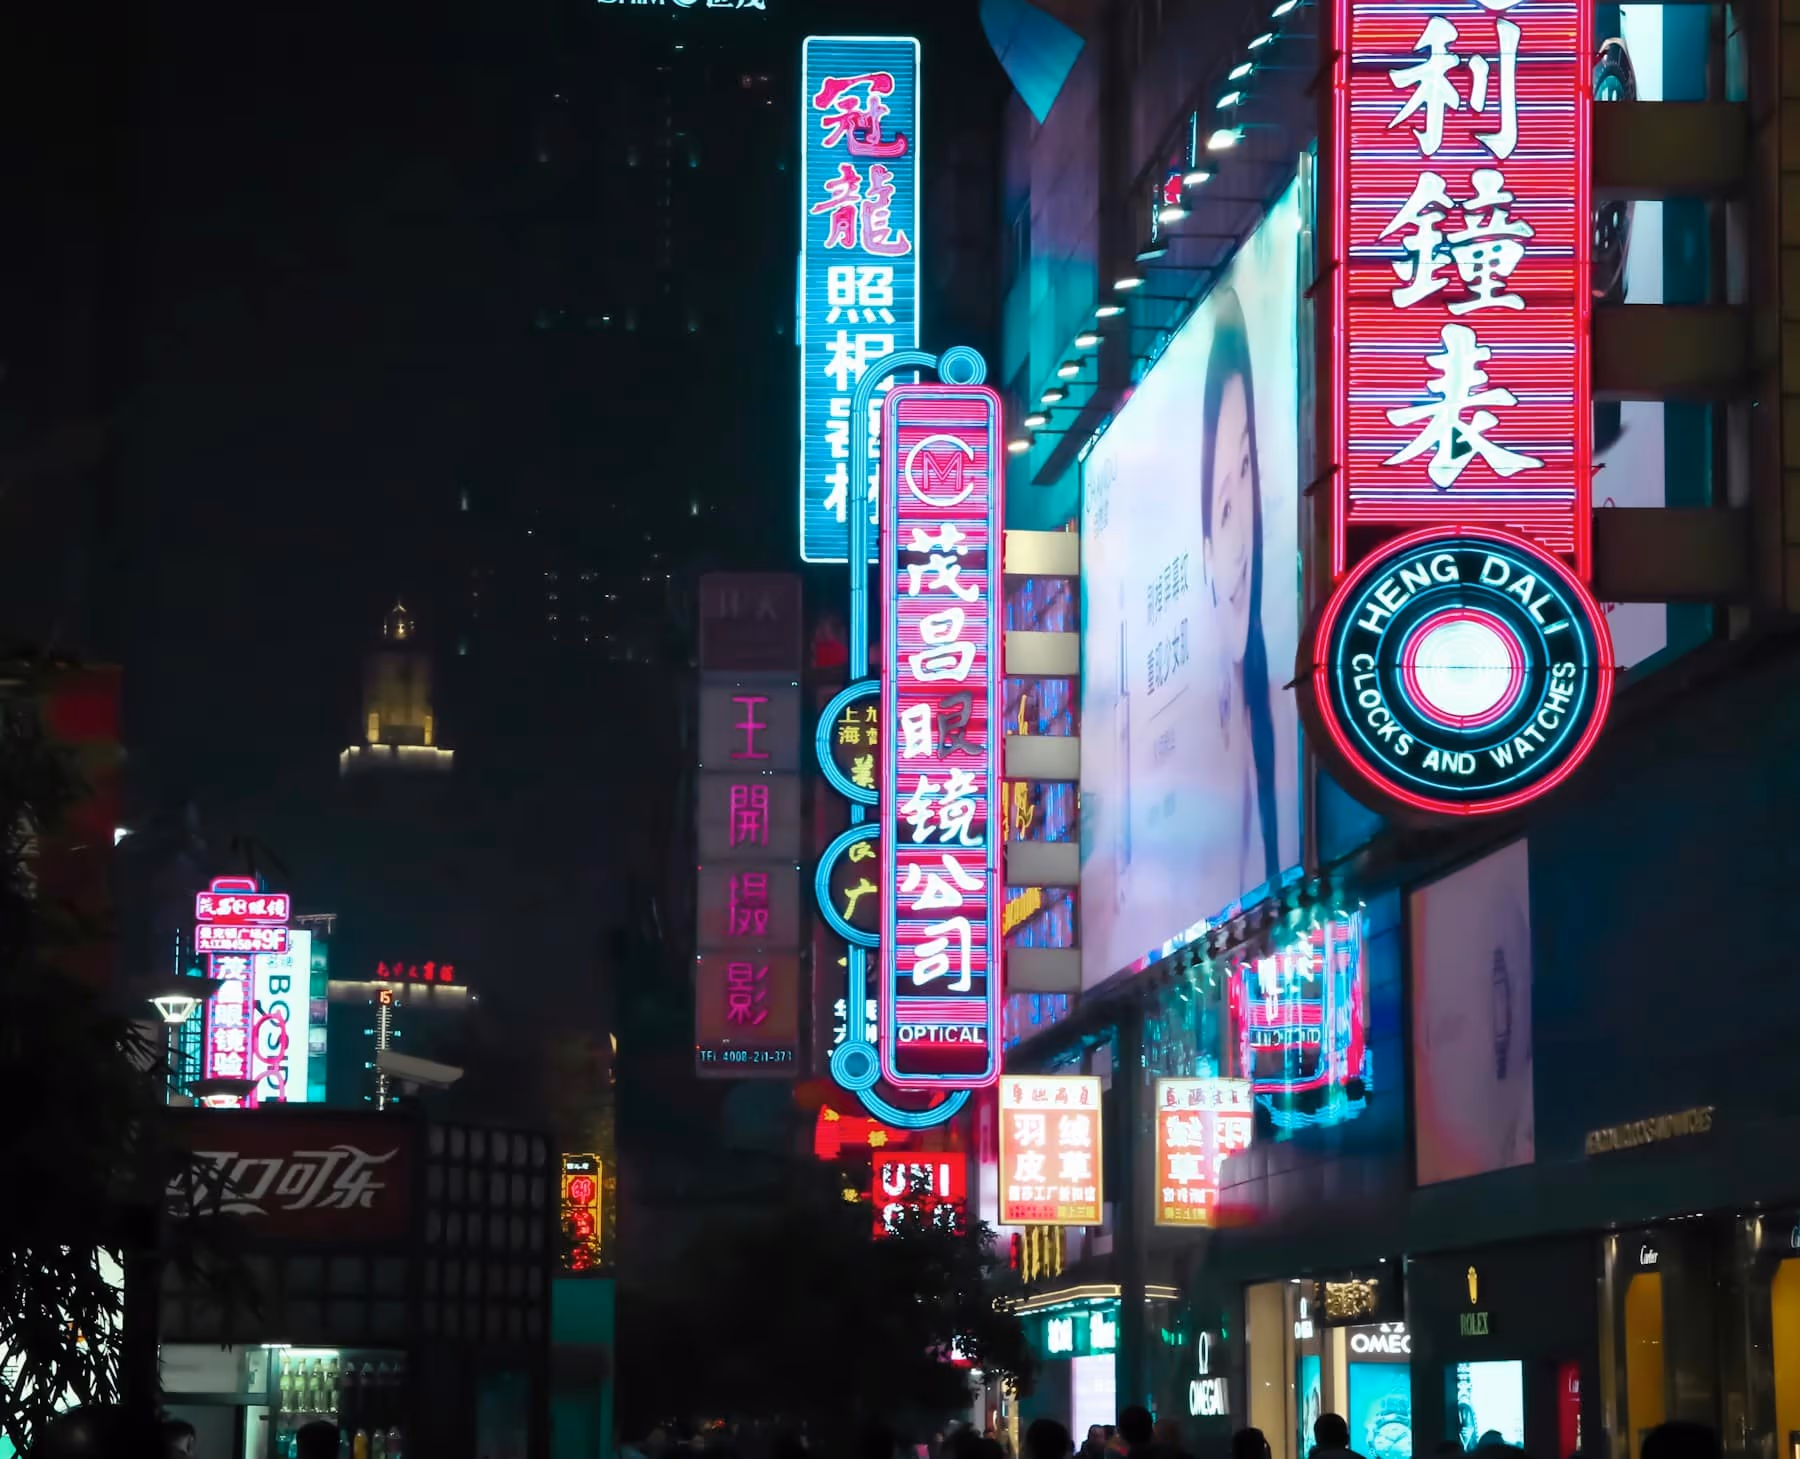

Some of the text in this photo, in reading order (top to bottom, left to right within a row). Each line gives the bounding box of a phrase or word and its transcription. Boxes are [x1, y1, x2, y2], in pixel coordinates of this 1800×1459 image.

[1357, 554, 1569, 634] HENG DALI
[1352, 653, 1576, 774] CLOCKS AND WATCHES
[900, 523, 984, 992] 茂昌眼镜公司
[898, 1026, 984, 1044] OPTICAL
[883, 1163, 949, 1197] UNI
[1189, 1378, 1225, 1415] OMEGA
